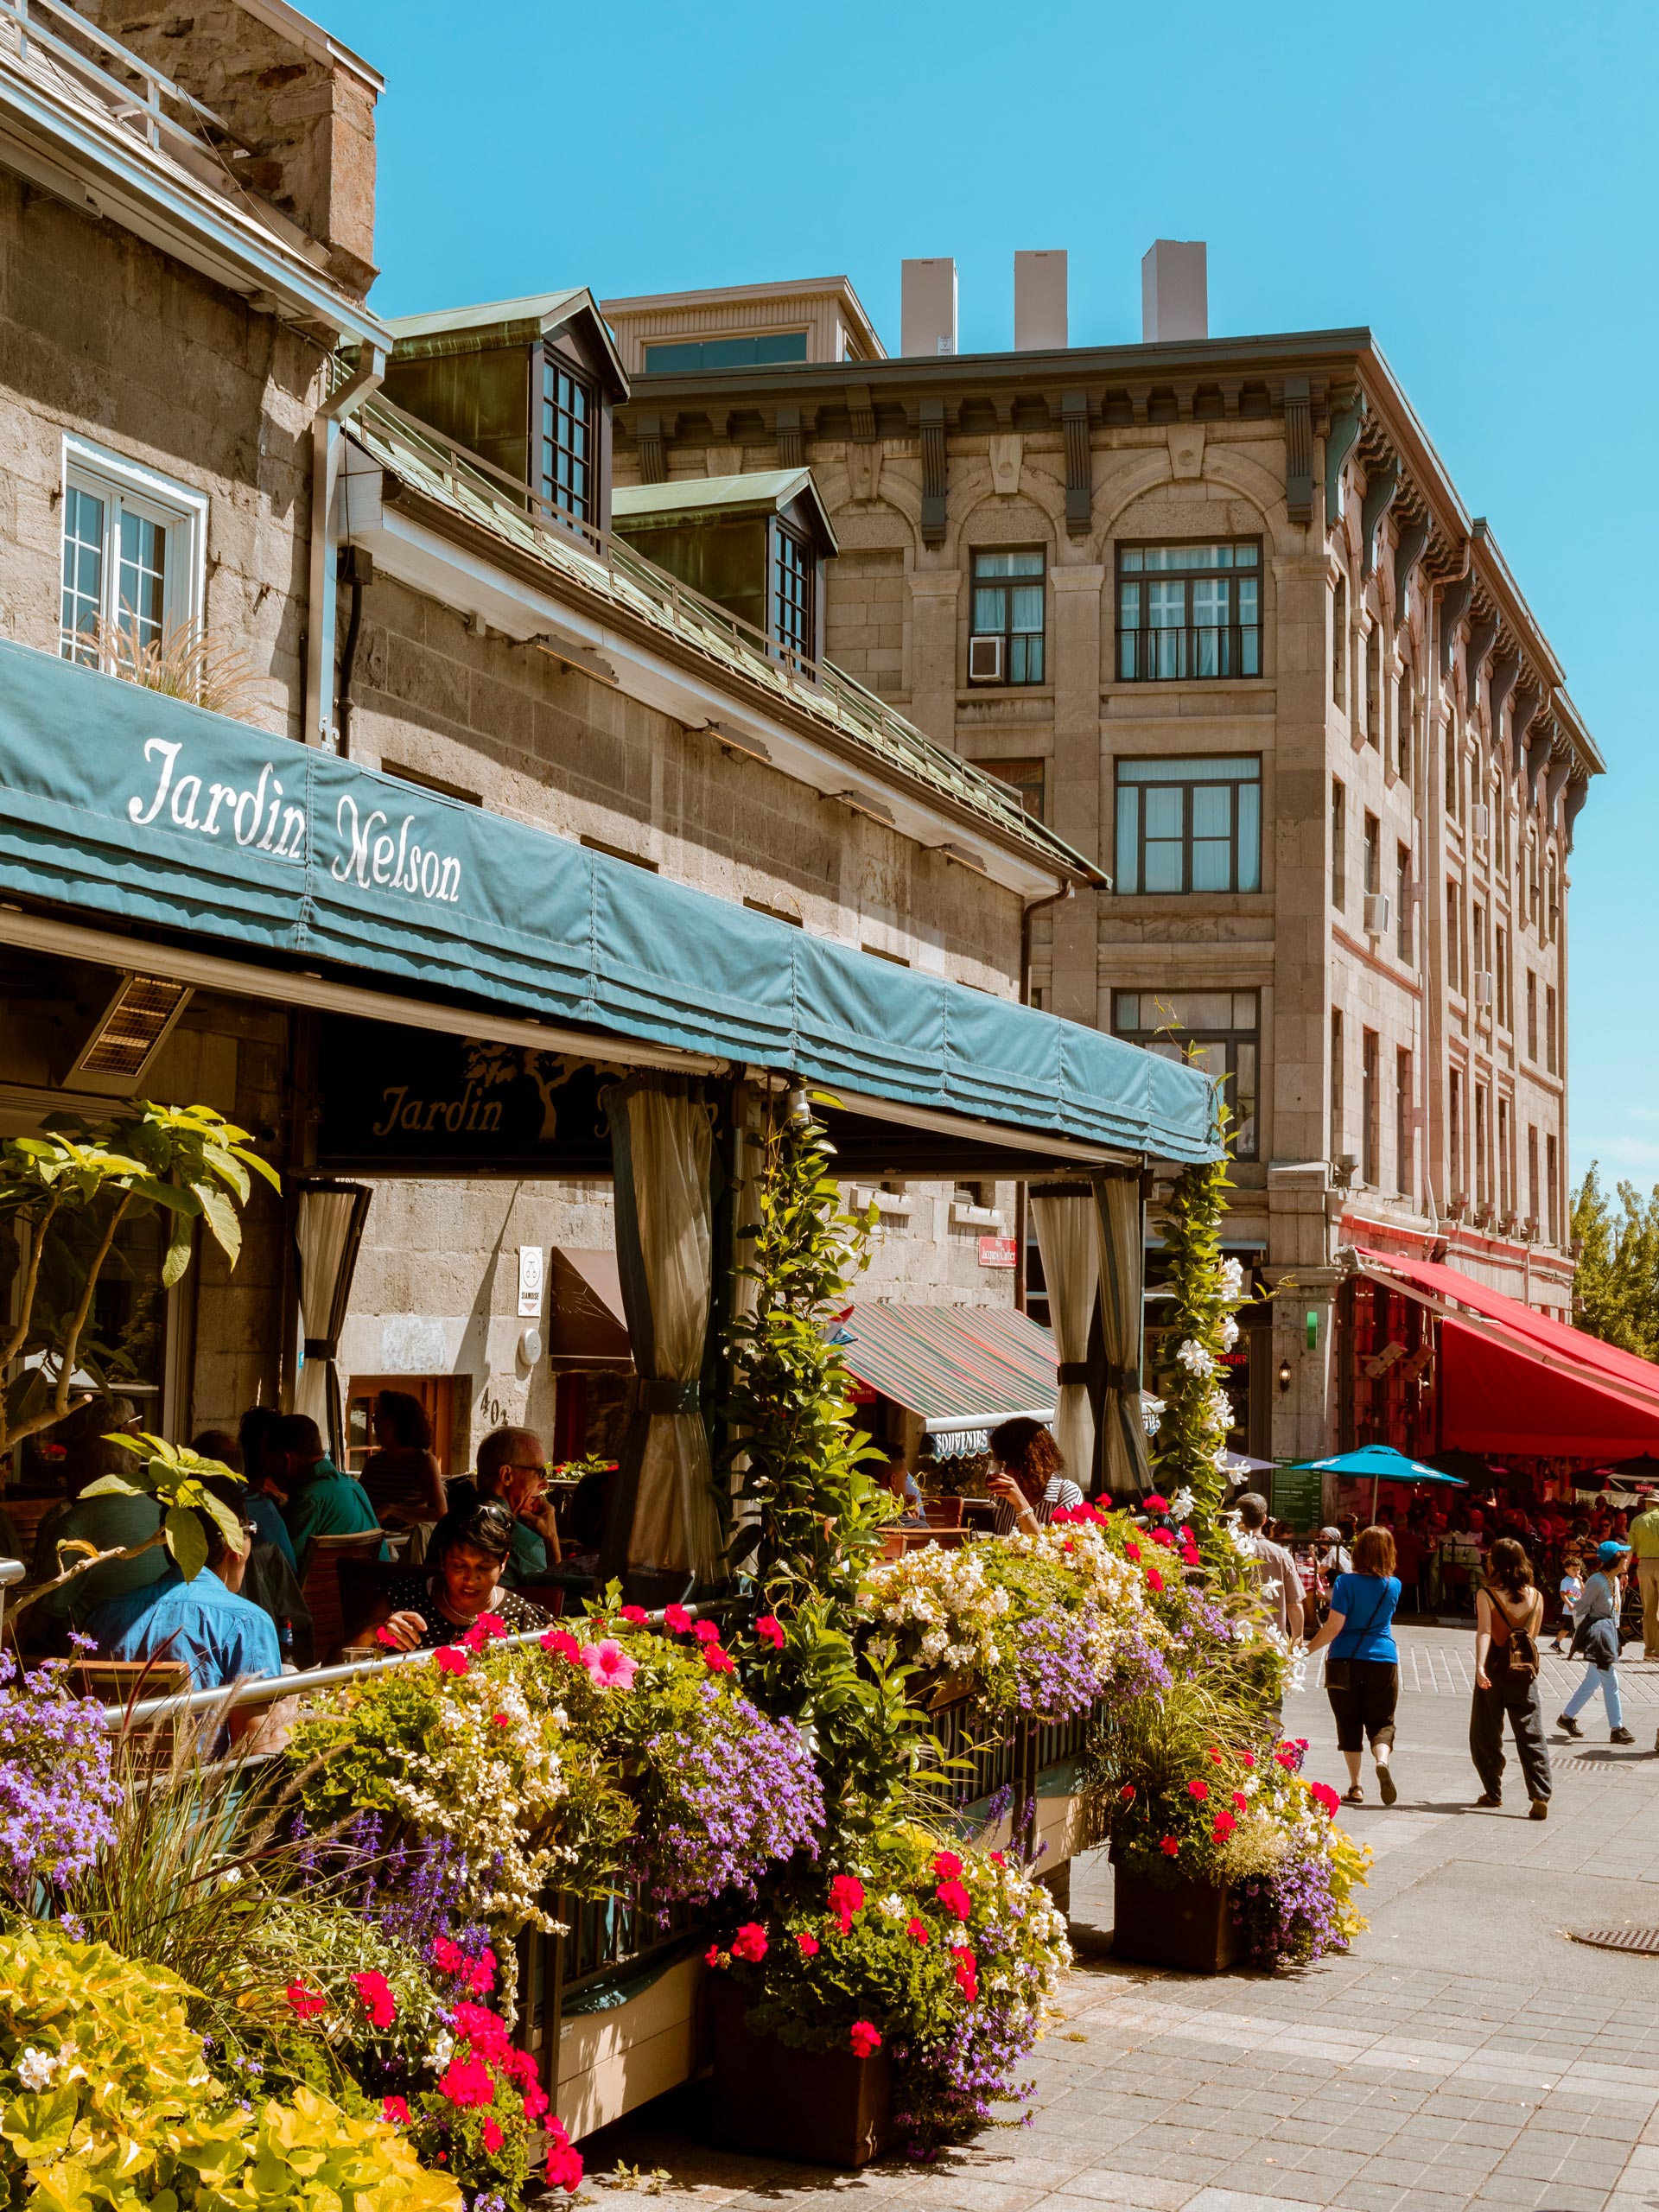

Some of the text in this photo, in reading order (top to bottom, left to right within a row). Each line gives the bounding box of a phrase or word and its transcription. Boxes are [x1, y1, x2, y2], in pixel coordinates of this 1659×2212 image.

[129, 738, 461, 902] Jardin Nelson
[373, 1080, 502, 1136] Jardin
[521, 1292, 539, 1300] SIAMOISE
[935, 1428, 988, 1454] SOUVENIRS
